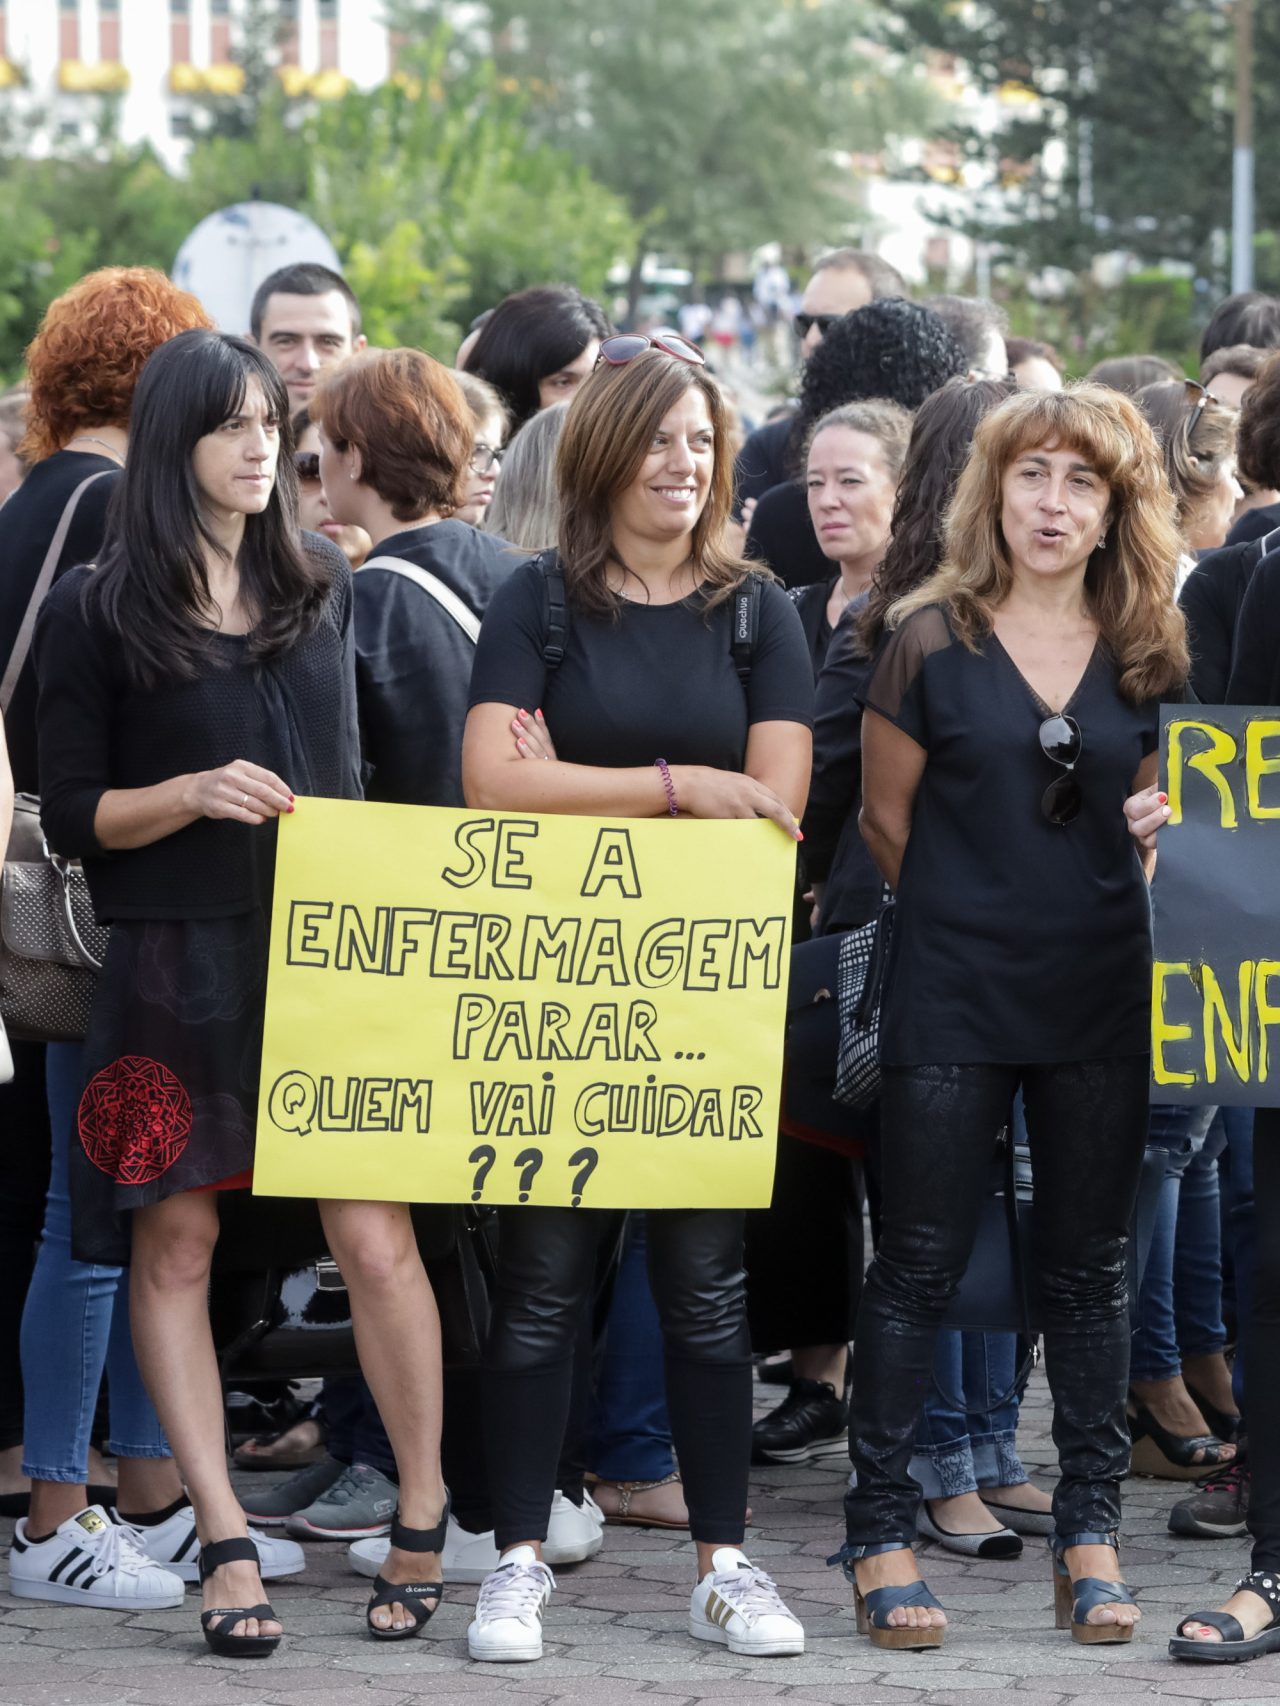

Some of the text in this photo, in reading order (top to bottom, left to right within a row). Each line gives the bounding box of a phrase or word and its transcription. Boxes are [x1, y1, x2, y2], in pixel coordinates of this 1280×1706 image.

[441, 819, 641, 899] SE A
[286, 900, 787, 992] ENFERMAGEM
[453, 993, 706, 1061] PARAR...
[267, 1070, 432, 1136] QUEM
